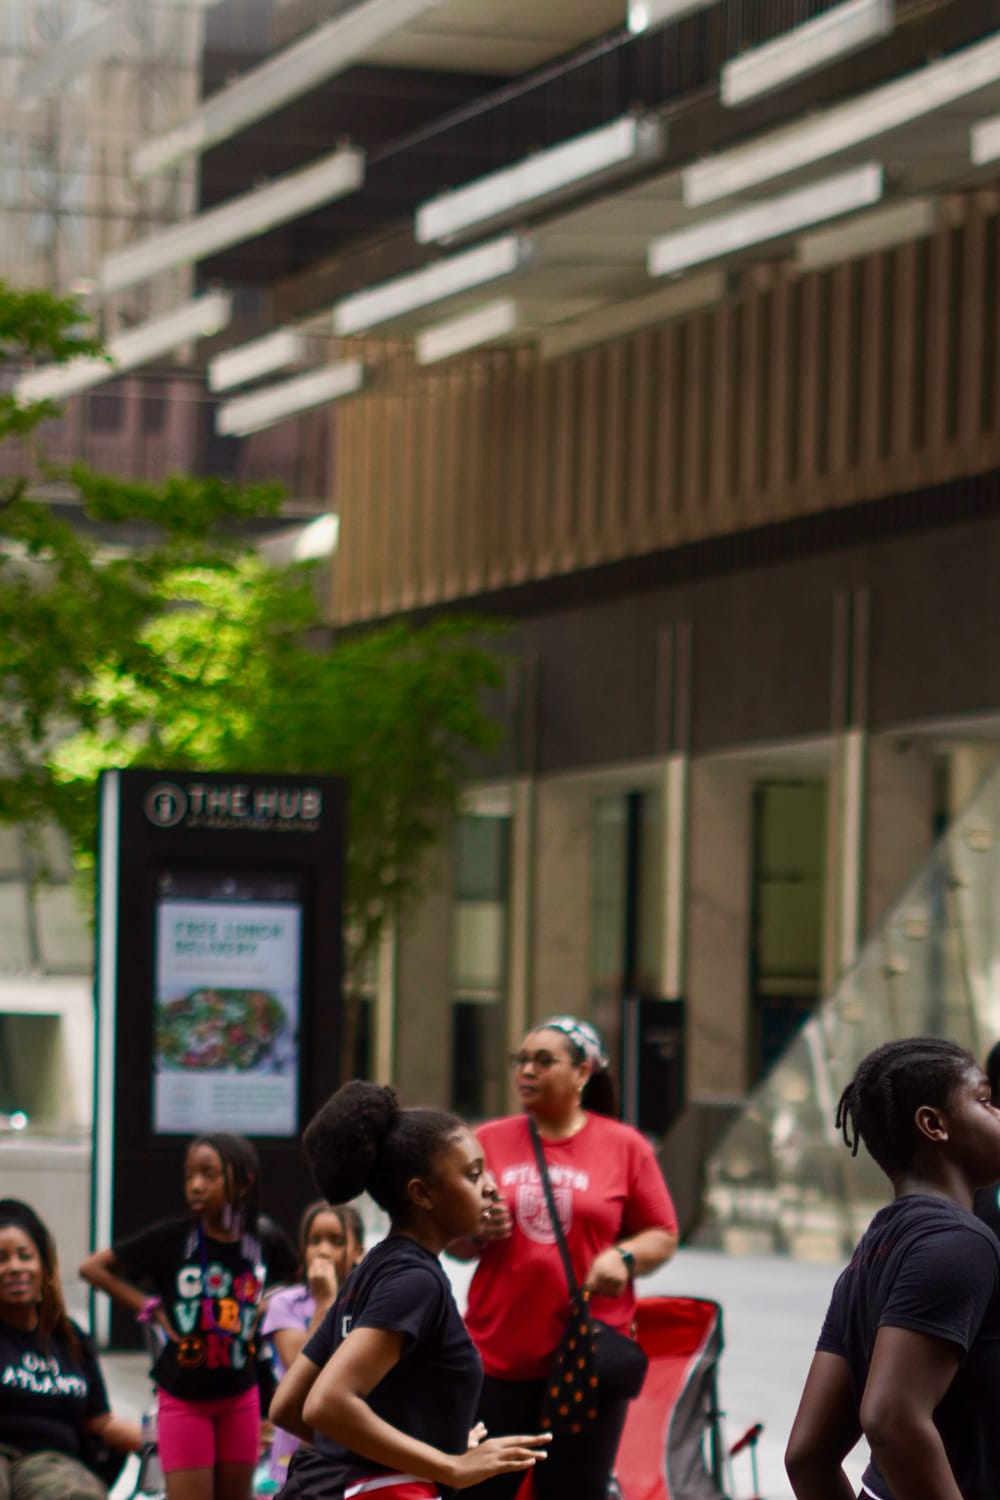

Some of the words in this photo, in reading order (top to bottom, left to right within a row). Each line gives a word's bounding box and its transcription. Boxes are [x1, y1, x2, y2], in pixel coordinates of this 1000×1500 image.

[187, 783, 250, 818] THE
[254, 786, 323, 820] HUB
[501, 1164, 590, 1193] ATLNTA
[174, 1298, 257, 1341] VIBE
[177, 1333, 256, 1370] ONL
